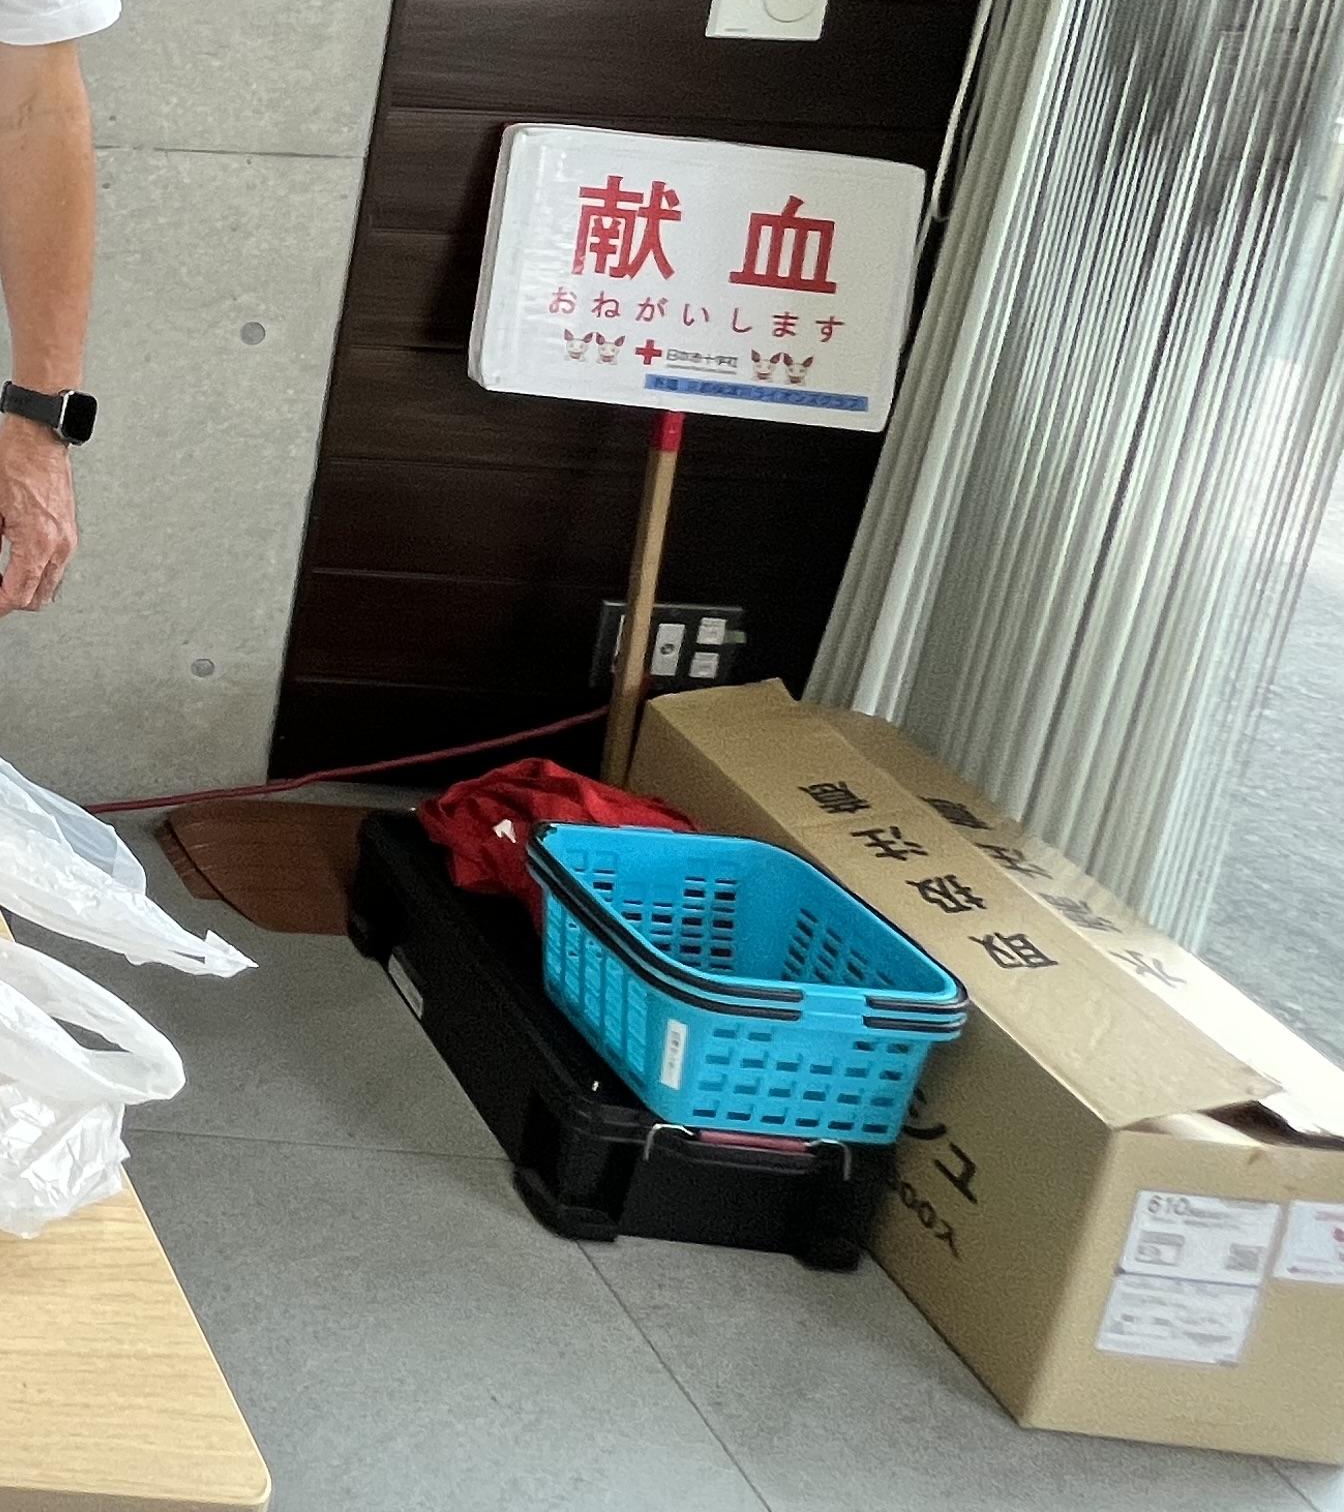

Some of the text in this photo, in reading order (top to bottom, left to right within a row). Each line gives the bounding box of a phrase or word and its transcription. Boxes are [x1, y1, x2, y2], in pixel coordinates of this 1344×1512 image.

[570, 174, 838, 294] 献血
[547, 285, 846, 343] おねがいします
